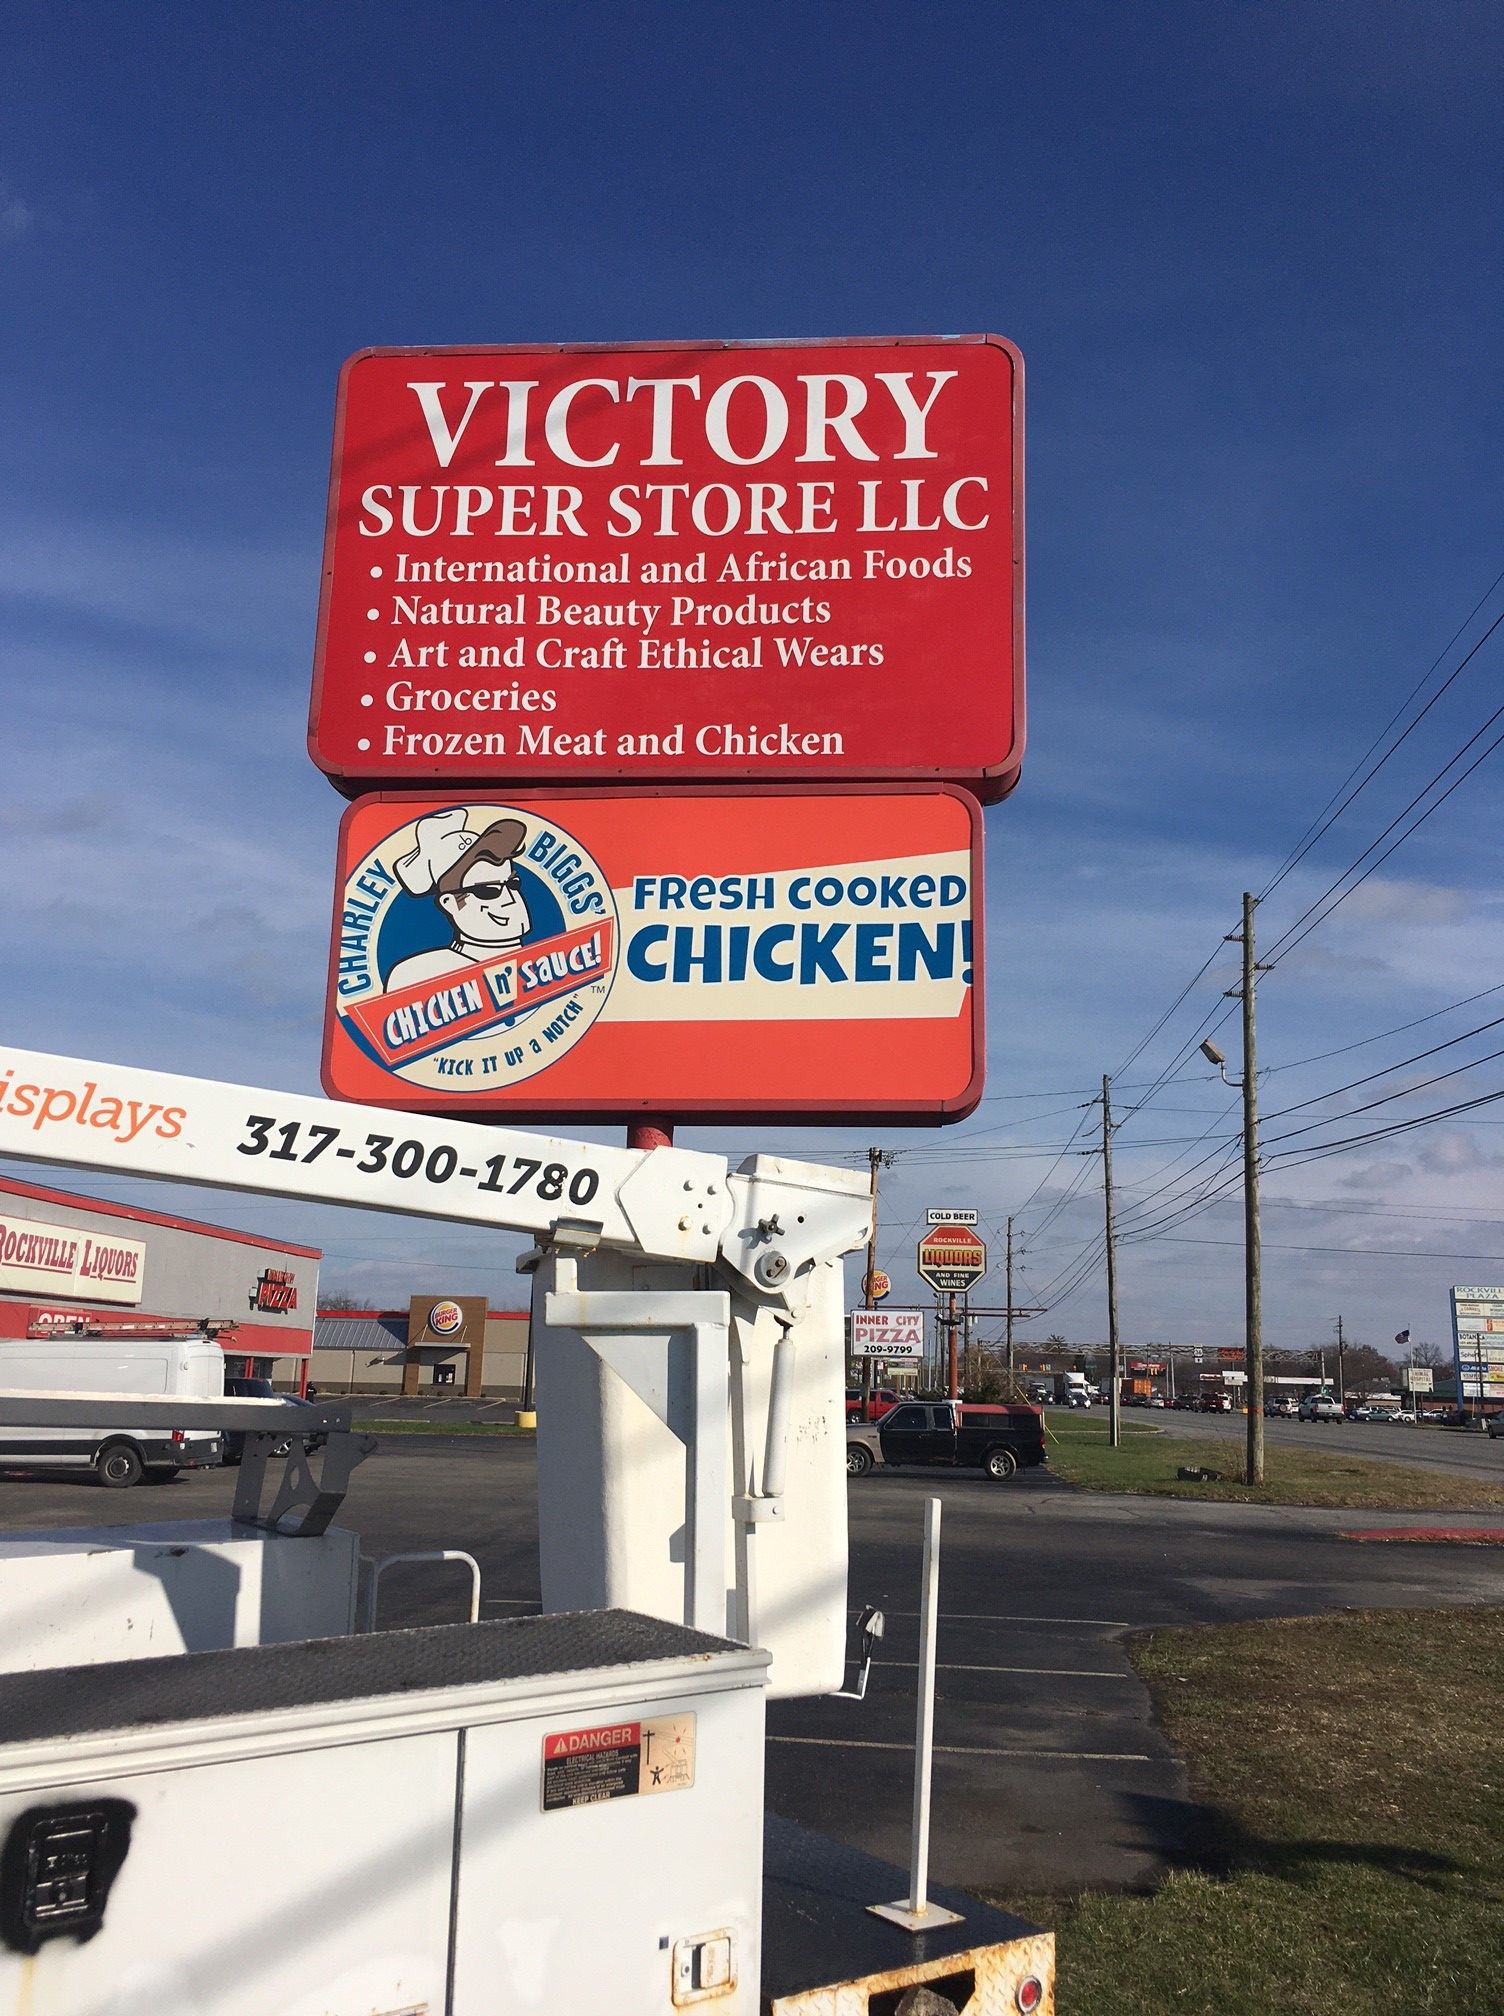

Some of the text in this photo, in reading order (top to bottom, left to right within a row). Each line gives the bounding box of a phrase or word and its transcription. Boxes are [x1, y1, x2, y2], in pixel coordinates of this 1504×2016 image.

[407, 371, 958, 467] VICTORY
[359, 477, 990, 537] SUPER STORE LLC
[395, 547, 972, 583] International and African Foods
[391, 594, 831, 635] Natural Beauty Products
[388, 637, 885, 669] Art and Craft Ethical Wears
[386, 681, 557, 711] Groceries
[383, 724, 844, 756] Frozen Meat and Chicken
[339, 858, 394, 995] CHARLEY
[627, 920, 974, 985] CHICKEN!
[385, 979, 483, 1048] CHICKEN
[482, 1056, 498, 1074] IT
[505, 1046, 524, 1067] UP
[237, 1114, 600, 1207] 317-300-1780
[929, 1212, 976, 1221] COLD BEER
[79, 1239, 139, 1281] LIQUORS
[922, 1248, 983, 1268] LIQUORS
[258, 1282, 298, 1309] PIZZA
[940, 1279, 966, 1287] WINES
[434, 1307, 458, 1319] BURGER
[435, 1313, 459, 1326] KING
[855, 1314, 920, 1326] INNER CITY
[855, 1327, 922, 1344] PIZZA
[863, 1345, 913, 1354] 209-9799
[569, 1728, 632, 1751] DANGER
[572, 1791, 611, 1805] KEEP CLEAR
